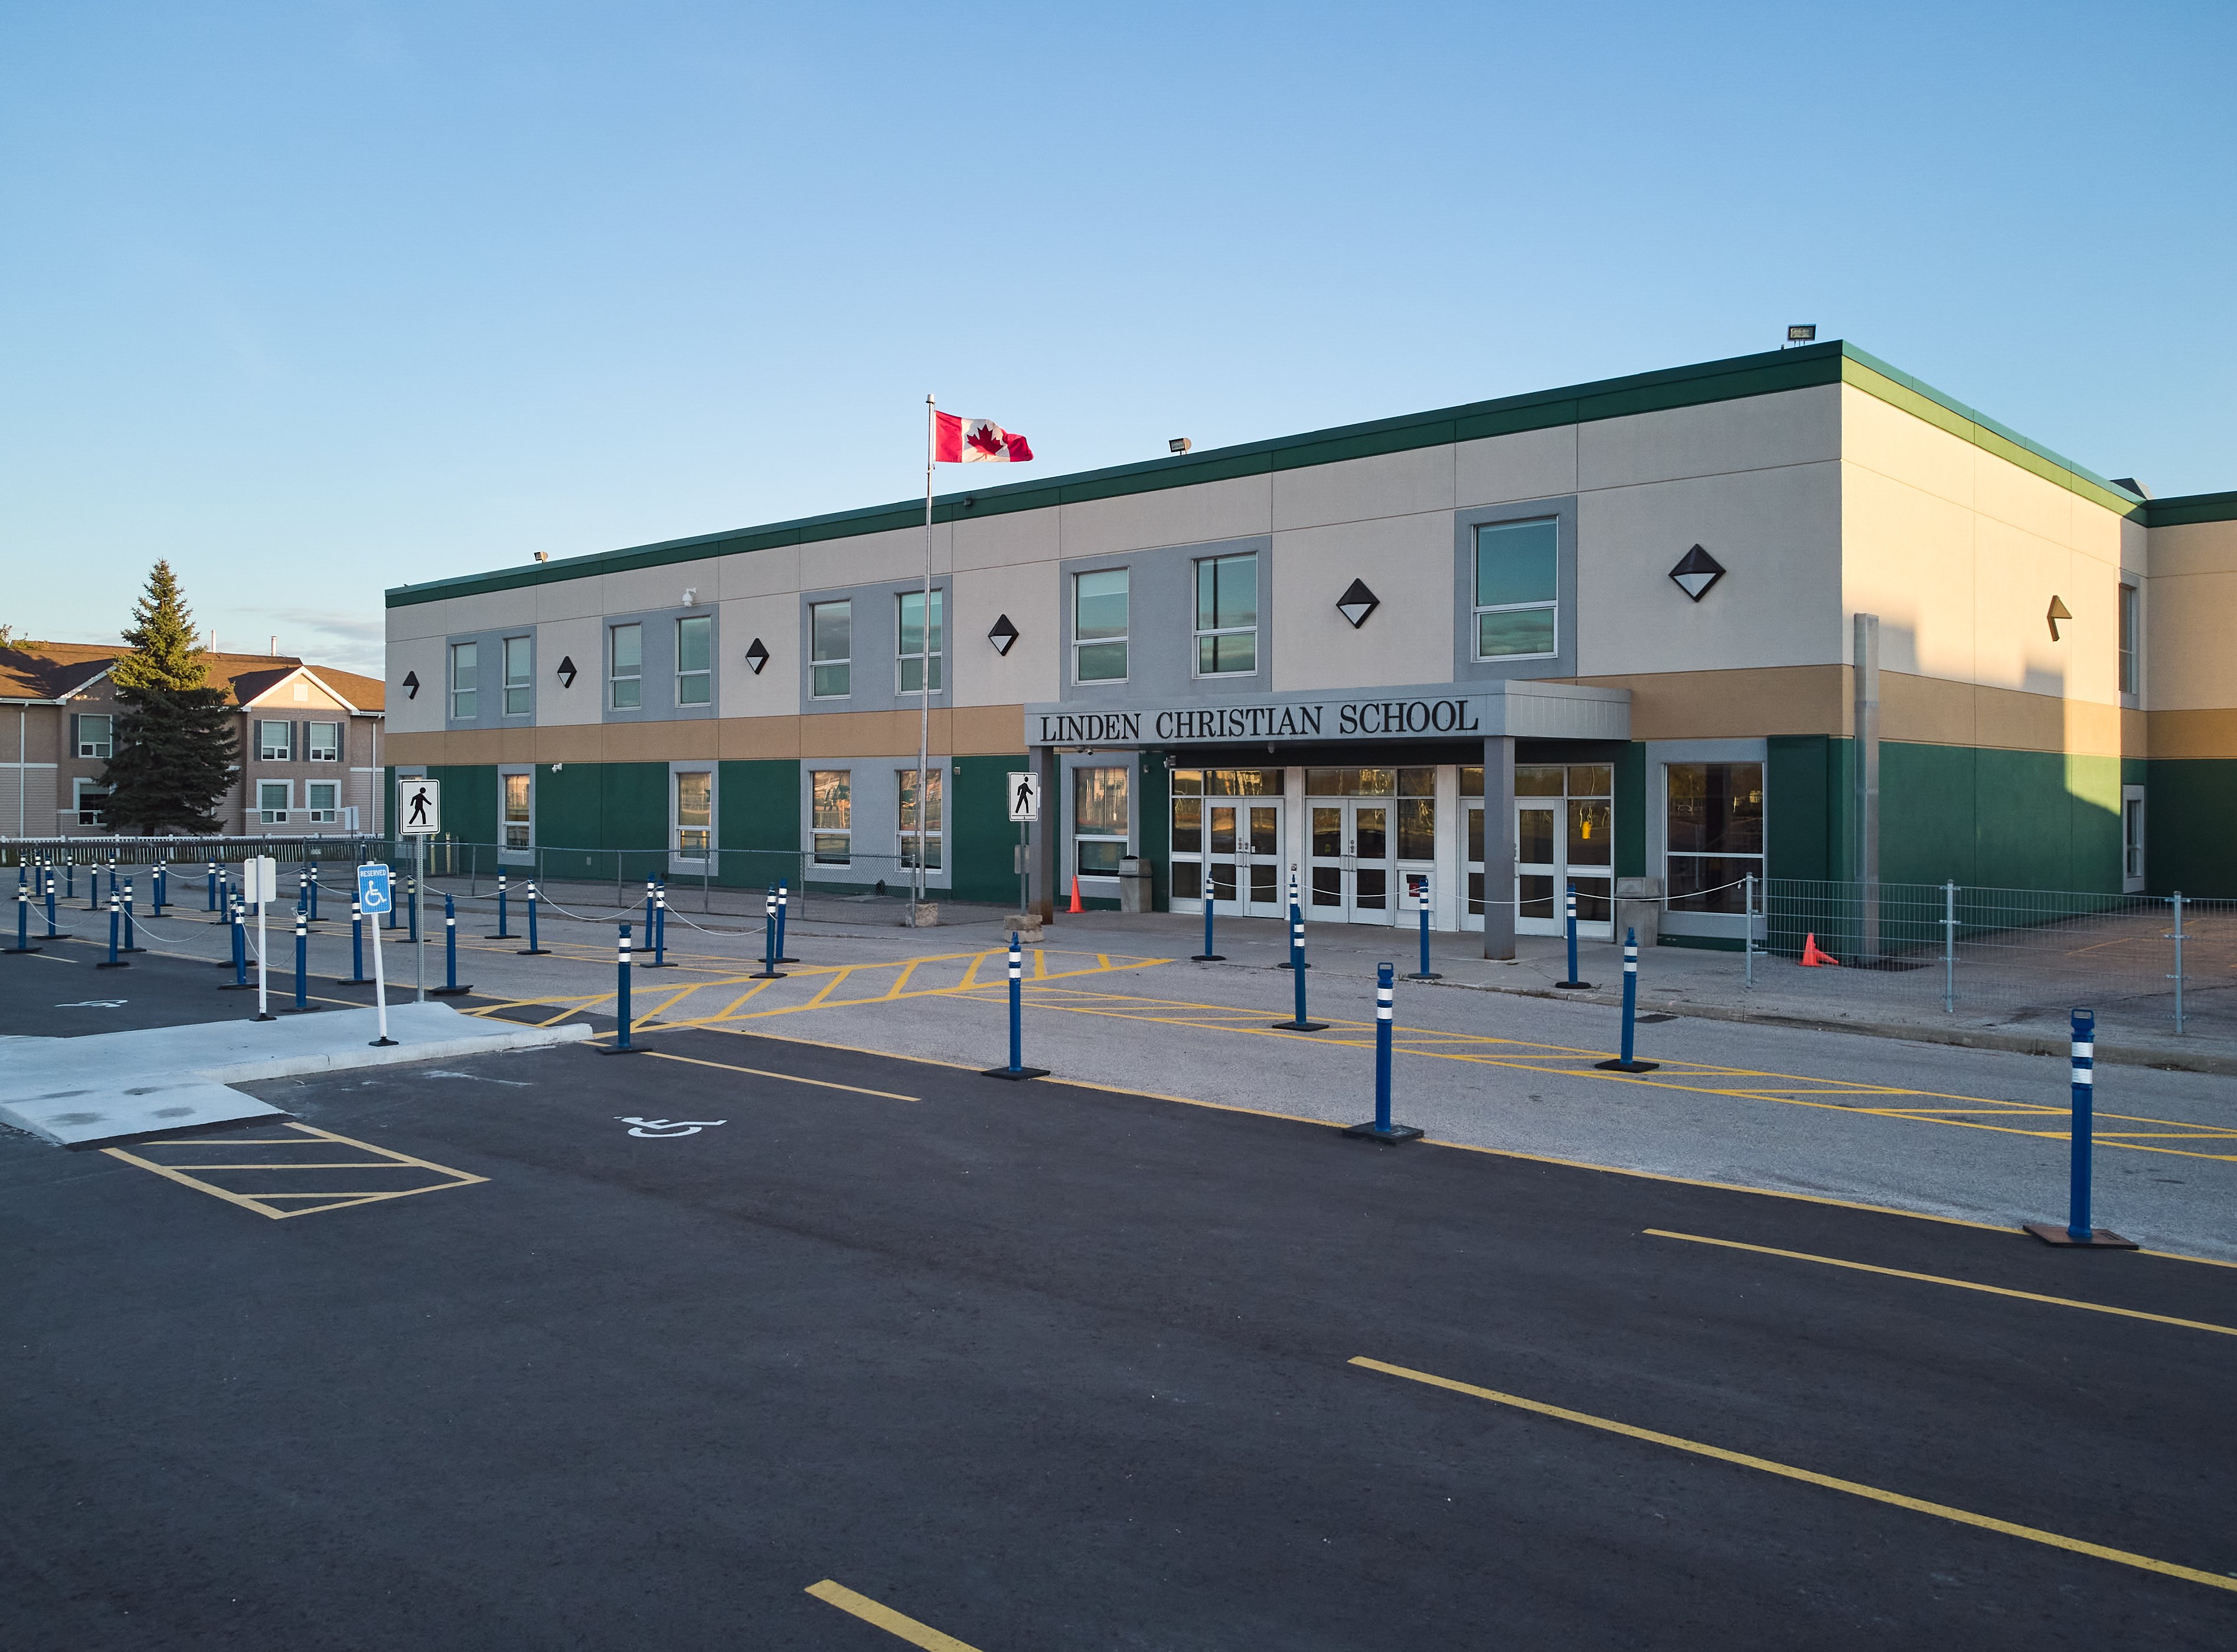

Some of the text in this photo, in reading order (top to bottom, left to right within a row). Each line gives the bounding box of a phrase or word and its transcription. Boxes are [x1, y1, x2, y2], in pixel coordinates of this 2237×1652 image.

[1040, 700, 1478, 742] LINDEN CHRISTIAN SCHOOL
